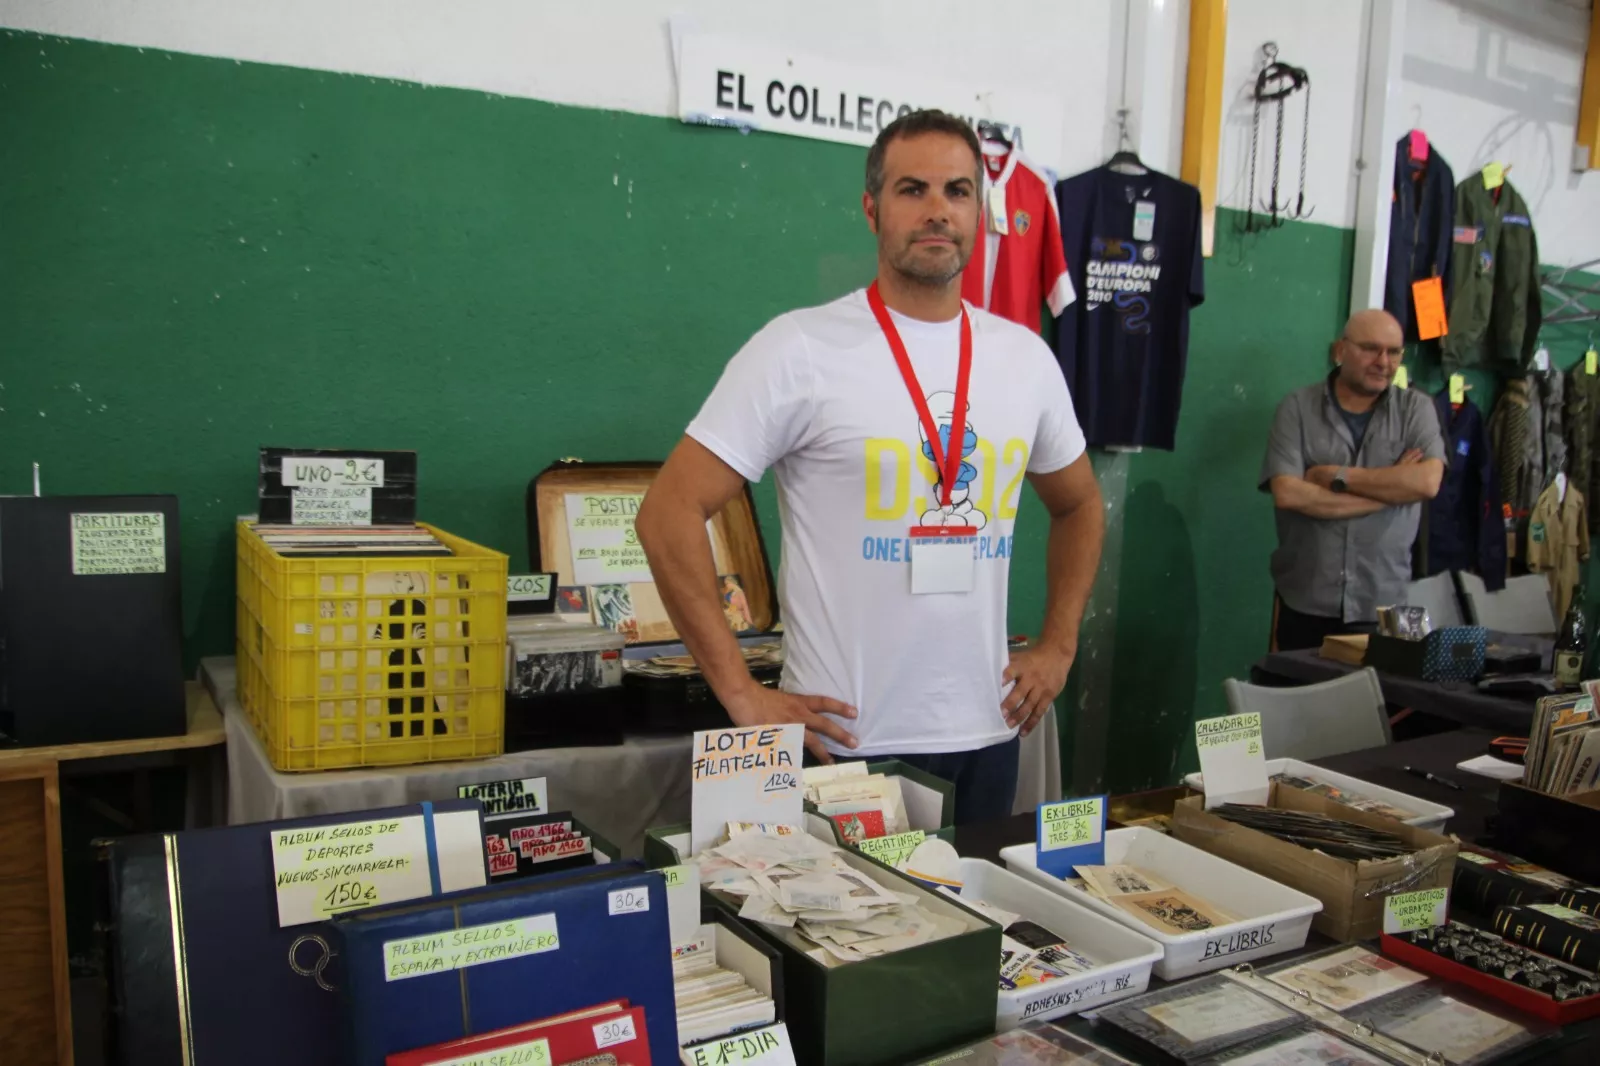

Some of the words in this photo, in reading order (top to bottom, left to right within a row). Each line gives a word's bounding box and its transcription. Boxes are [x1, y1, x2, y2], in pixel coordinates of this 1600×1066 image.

[716, 70, 754, 113] EL
[1087, 261, 1161, 280] CAMPIONI
[1087, 276, 1151, 292] D'EUROPA
[1088, 290, 1112, 302] 2010
[74, 514, 160, 528] PARTITURAS
[575, 518, 587, 527] SE
[590, 518, 620, 527] VENDE
[863, 536, 901, 562] ONE
[1197, 714, 1259, 735] CALENDARIOS
[705, 728, 783, 752] LOTE
[693, 748, 792, 780] FILATELIA
[464, 780, 524, 799] LOTERIA
[764, 773, 796, 788] 120€
[279, 831, 326, 847] ALBUM
[329, 825, 373, 840] SELLOS
[379, 823, 399, 833] DE
[511, 827, 534, 840] AÑO
[537, 823, 565, 836] 1966
[306, 843, 374, 861] DEPORTES
[533, 844, 556, 858] AÑO
[559, 839, 584, 852] 1960
[860, 832, 921, 853] PEGATINAS
[614, 892, 645, 909] 30€
[391, 938, 445, 959] ALBUM
[452, 924, 517, 947] SELLOS
[1204, 923, 1275, 957] EX-LIBRIS
[390, 957, 445, 977] ESPAÑA
[450, 954, 462, 970] Y
[465, 934, 558, 962] EXTRANJERO
[600, 1022, 632, 1041] 30€
[738, 1031, 779, 1059] DIA
